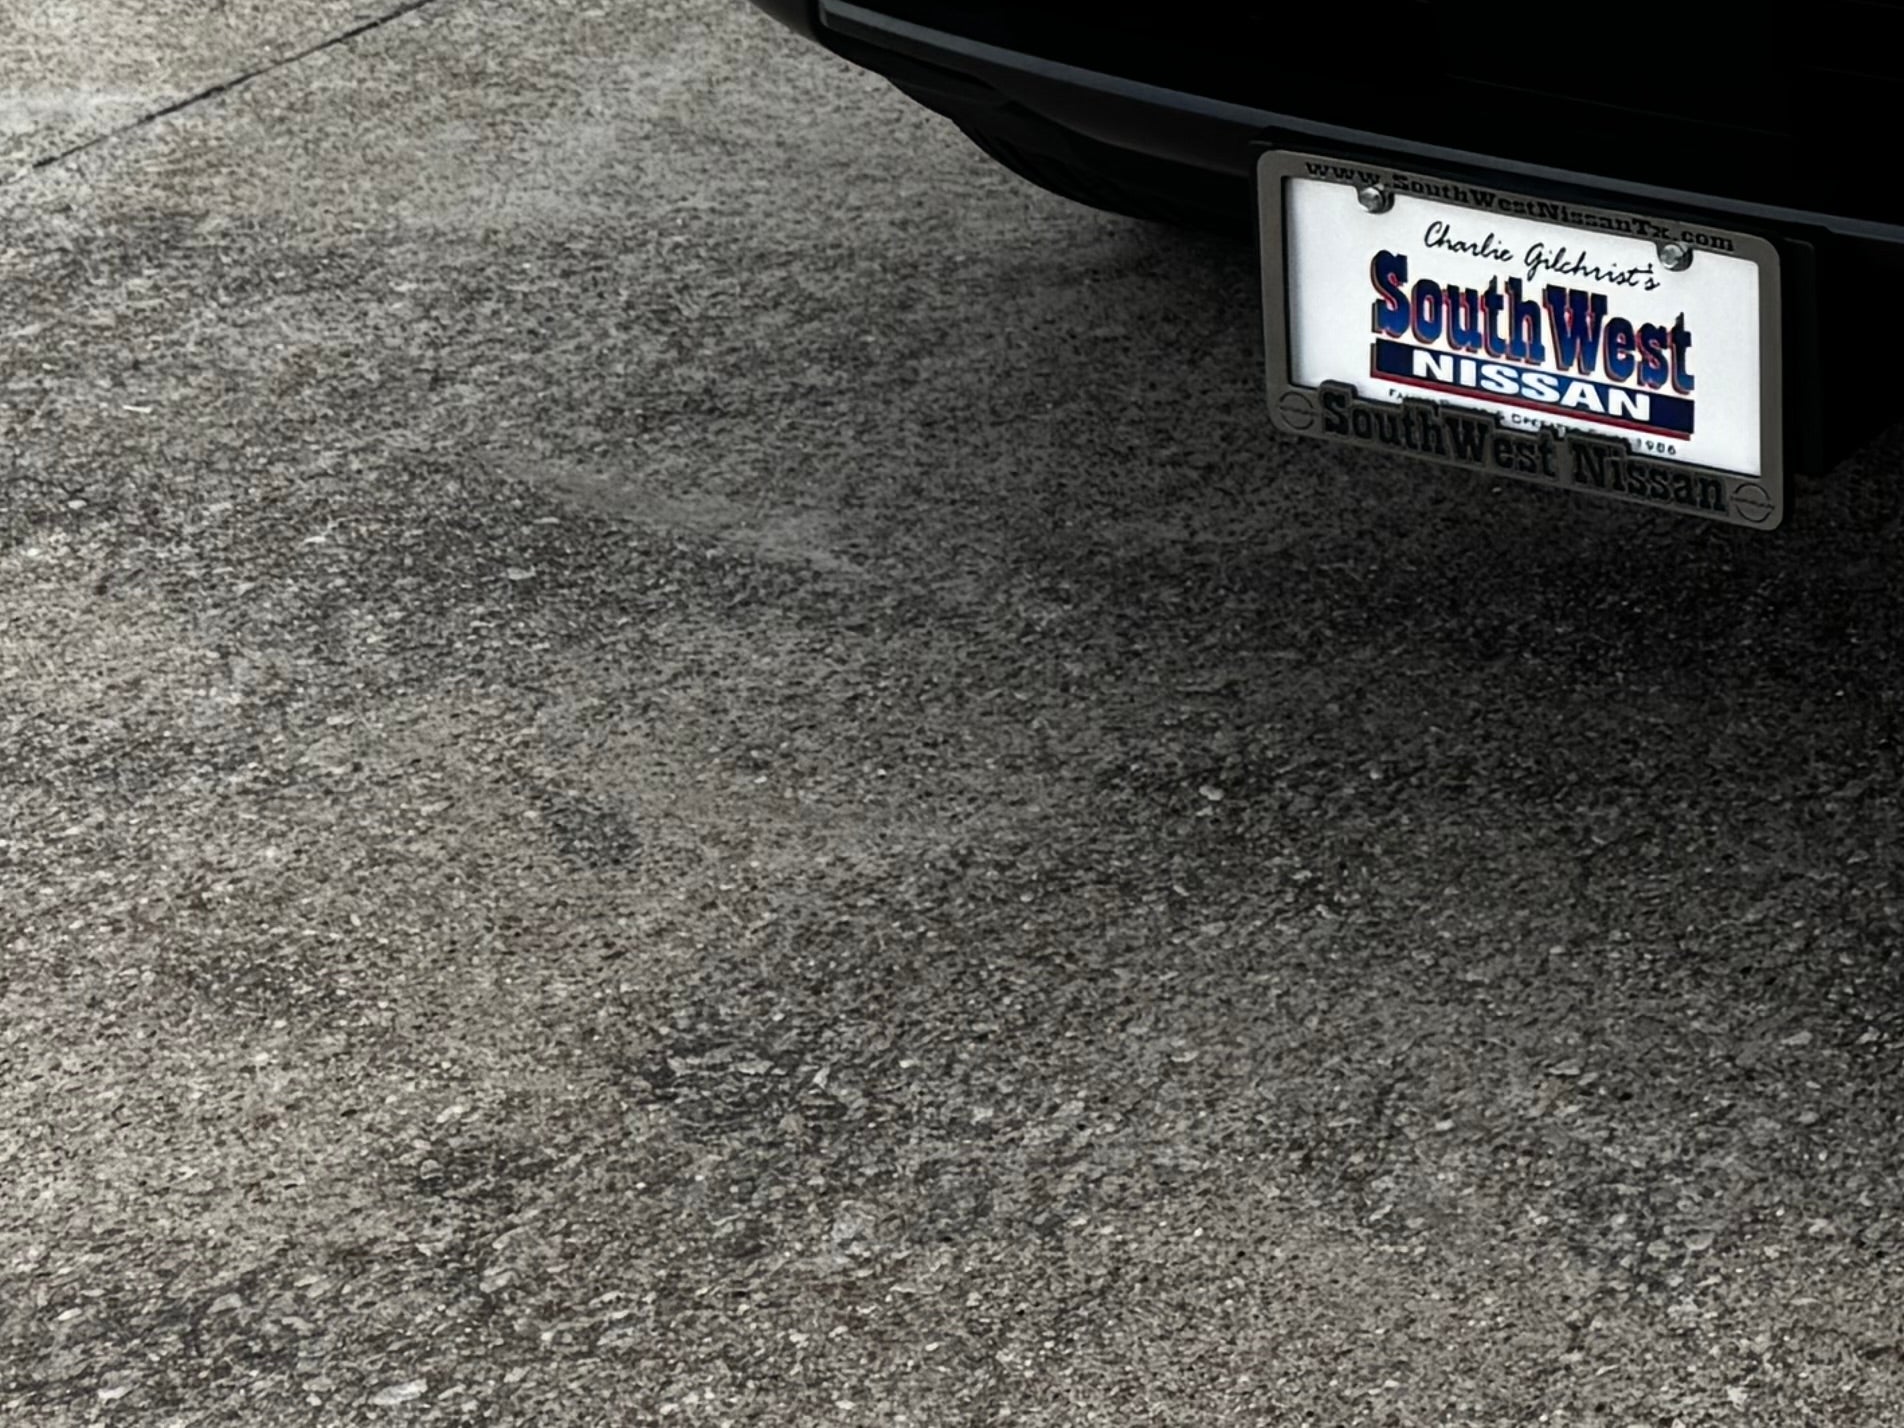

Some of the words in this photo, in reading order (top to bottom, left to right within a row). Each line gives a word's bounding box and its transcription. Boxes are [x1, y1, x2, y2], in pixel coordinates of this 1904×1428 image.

[1305, 161, 1735, 253] www.SouthWestNissanTx.com
[1423, 220, 1514, 263] Charlie
[1523, 242, 1661, 292] Gilchrist's
[1370, 249, 1695, 396] SouthWest
[1411, 348, 1651, 422] NISSAN
[1321, 391, 1557, 477] SouthWest
[1572, 440, 1729, 513] Nissan
